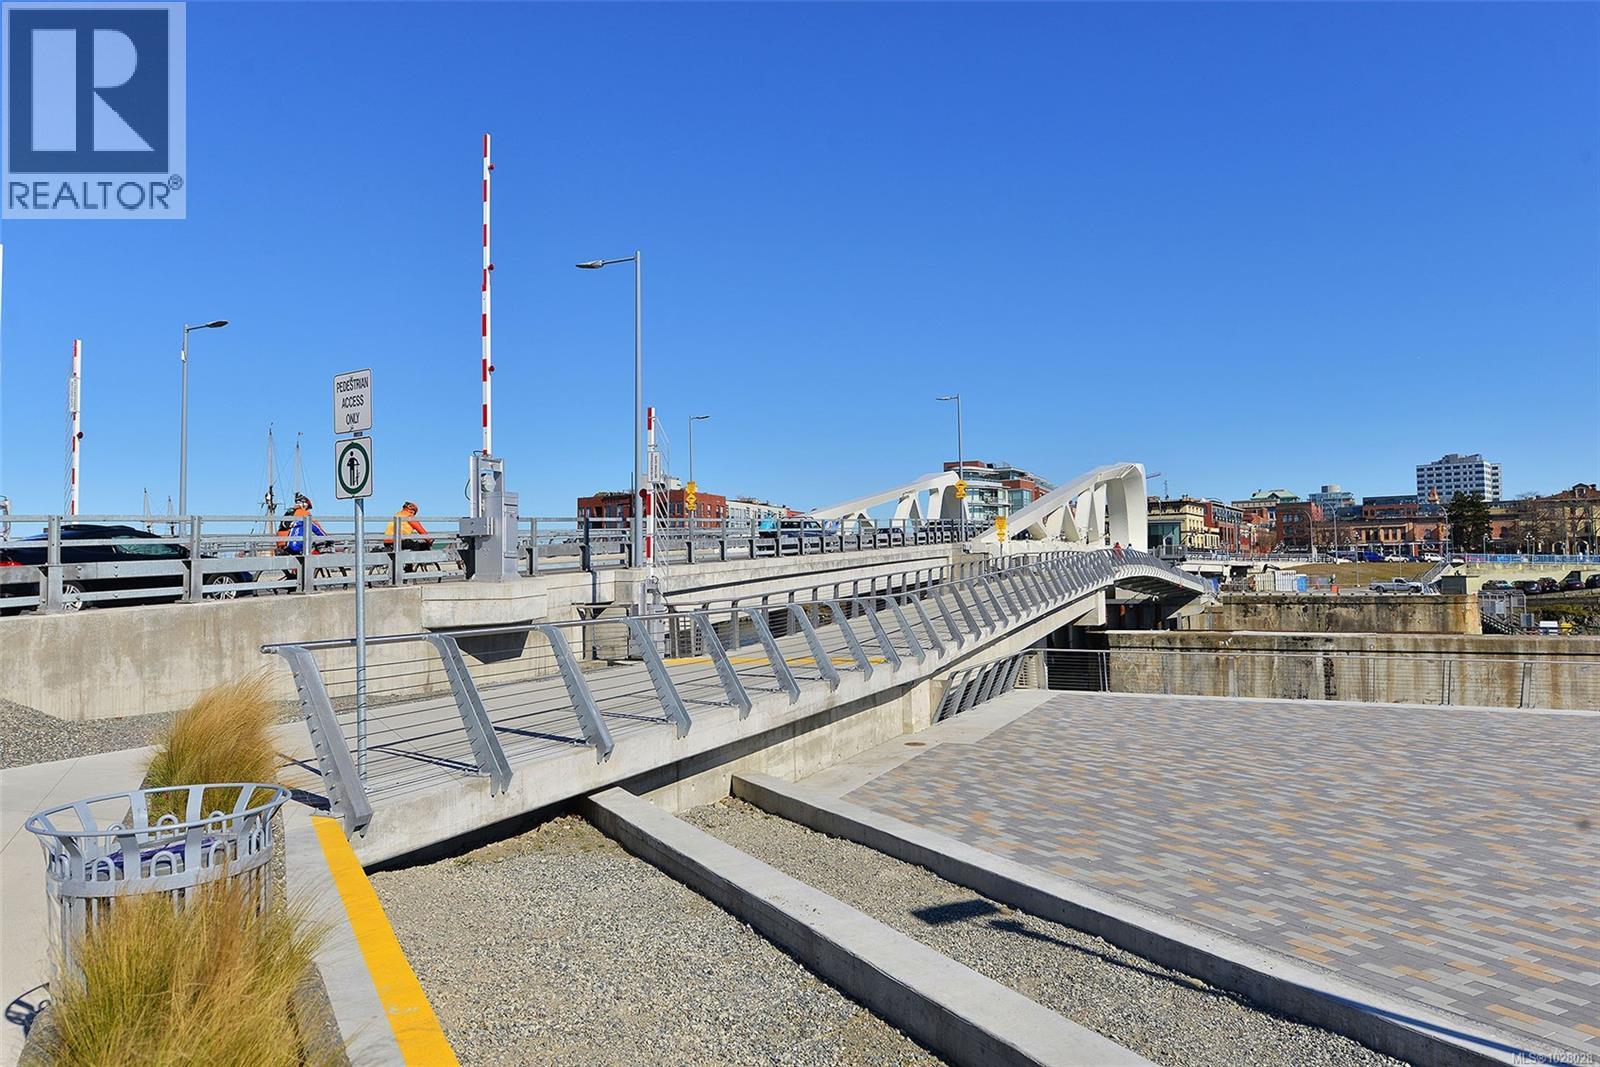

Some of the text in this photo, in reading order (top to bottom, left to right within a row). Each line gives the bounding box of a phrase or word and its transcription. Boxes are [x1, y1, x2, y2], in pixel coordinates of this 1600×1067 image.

[336, 377, 369, 393] PEDESTRIAN
[341, 394, 365, 409] ACCESS
[345, 412, 360, 425] ONLY
